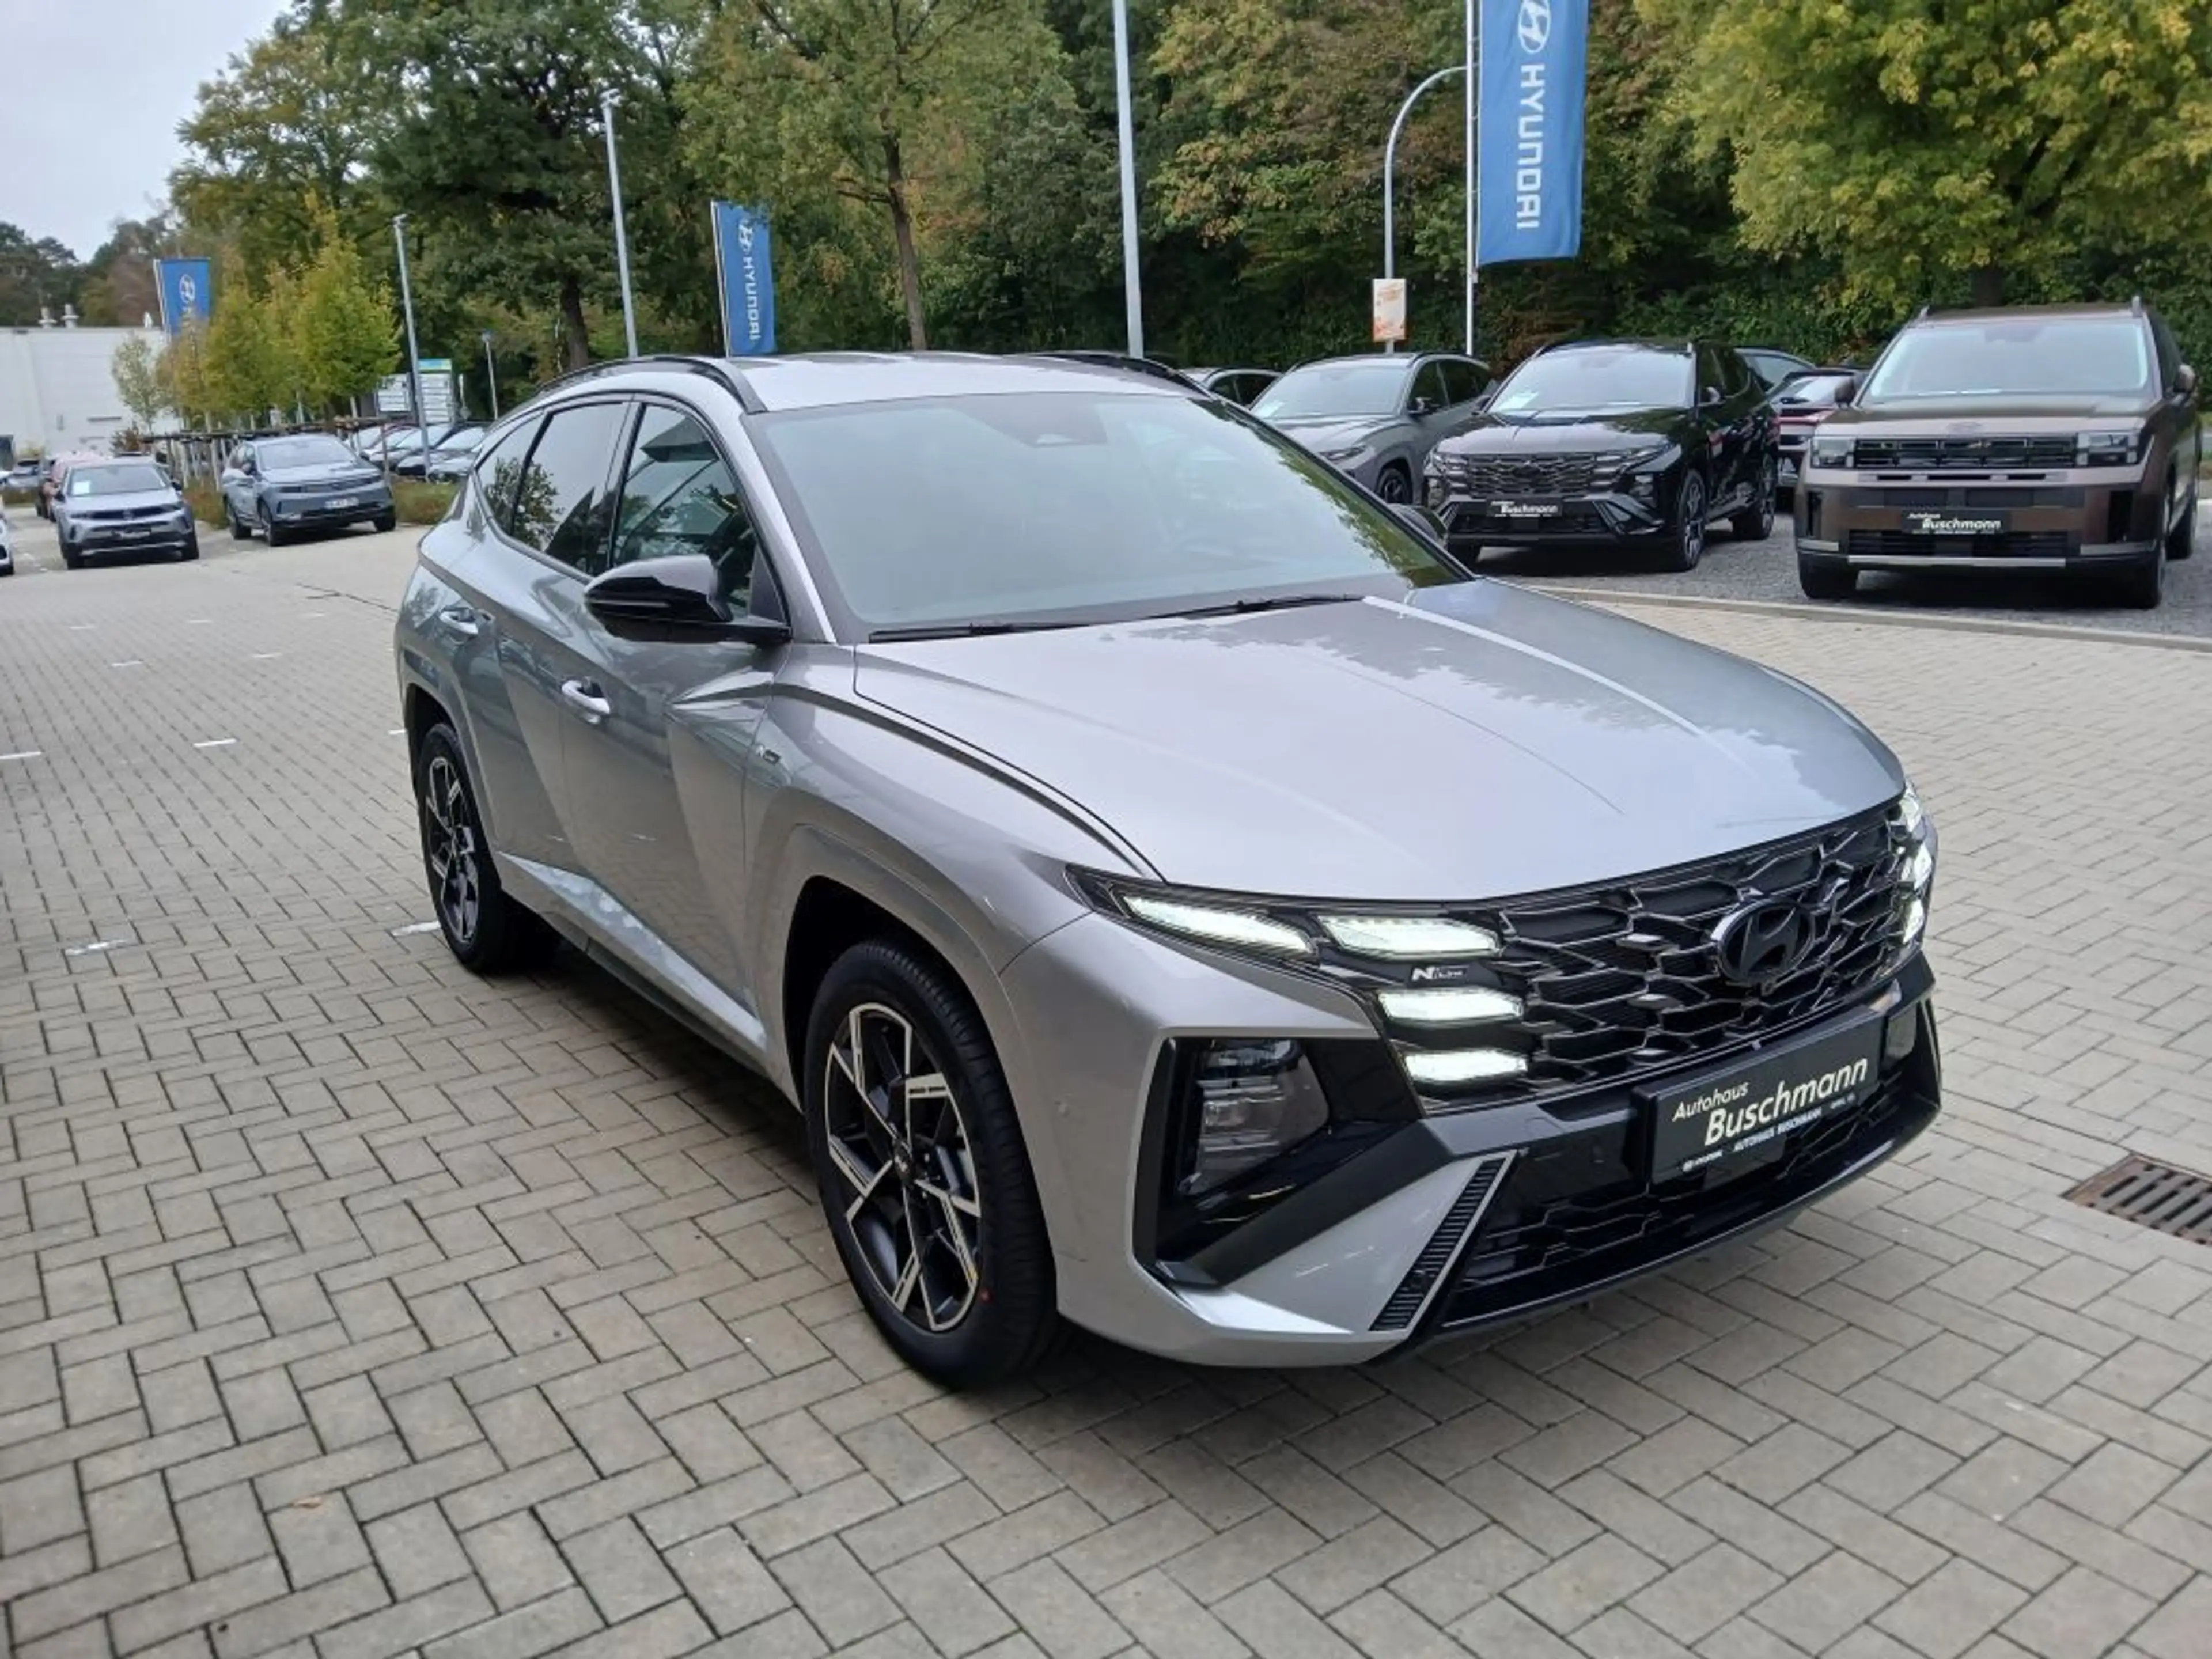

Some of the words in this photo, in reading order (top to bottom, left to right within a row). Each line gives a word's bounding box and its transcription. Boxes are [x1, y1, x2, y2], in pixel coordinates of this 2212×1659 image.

[1516, 63, 1546, 229] HYUNDAI
[743, 256, 762, 340] HYUNDAI
[1922, 517, 2001, 530] Buschmann
[1672, 1082, 1749, 1122] Autohaus
[1704, 1058, 1868, 1146] Buschmann
